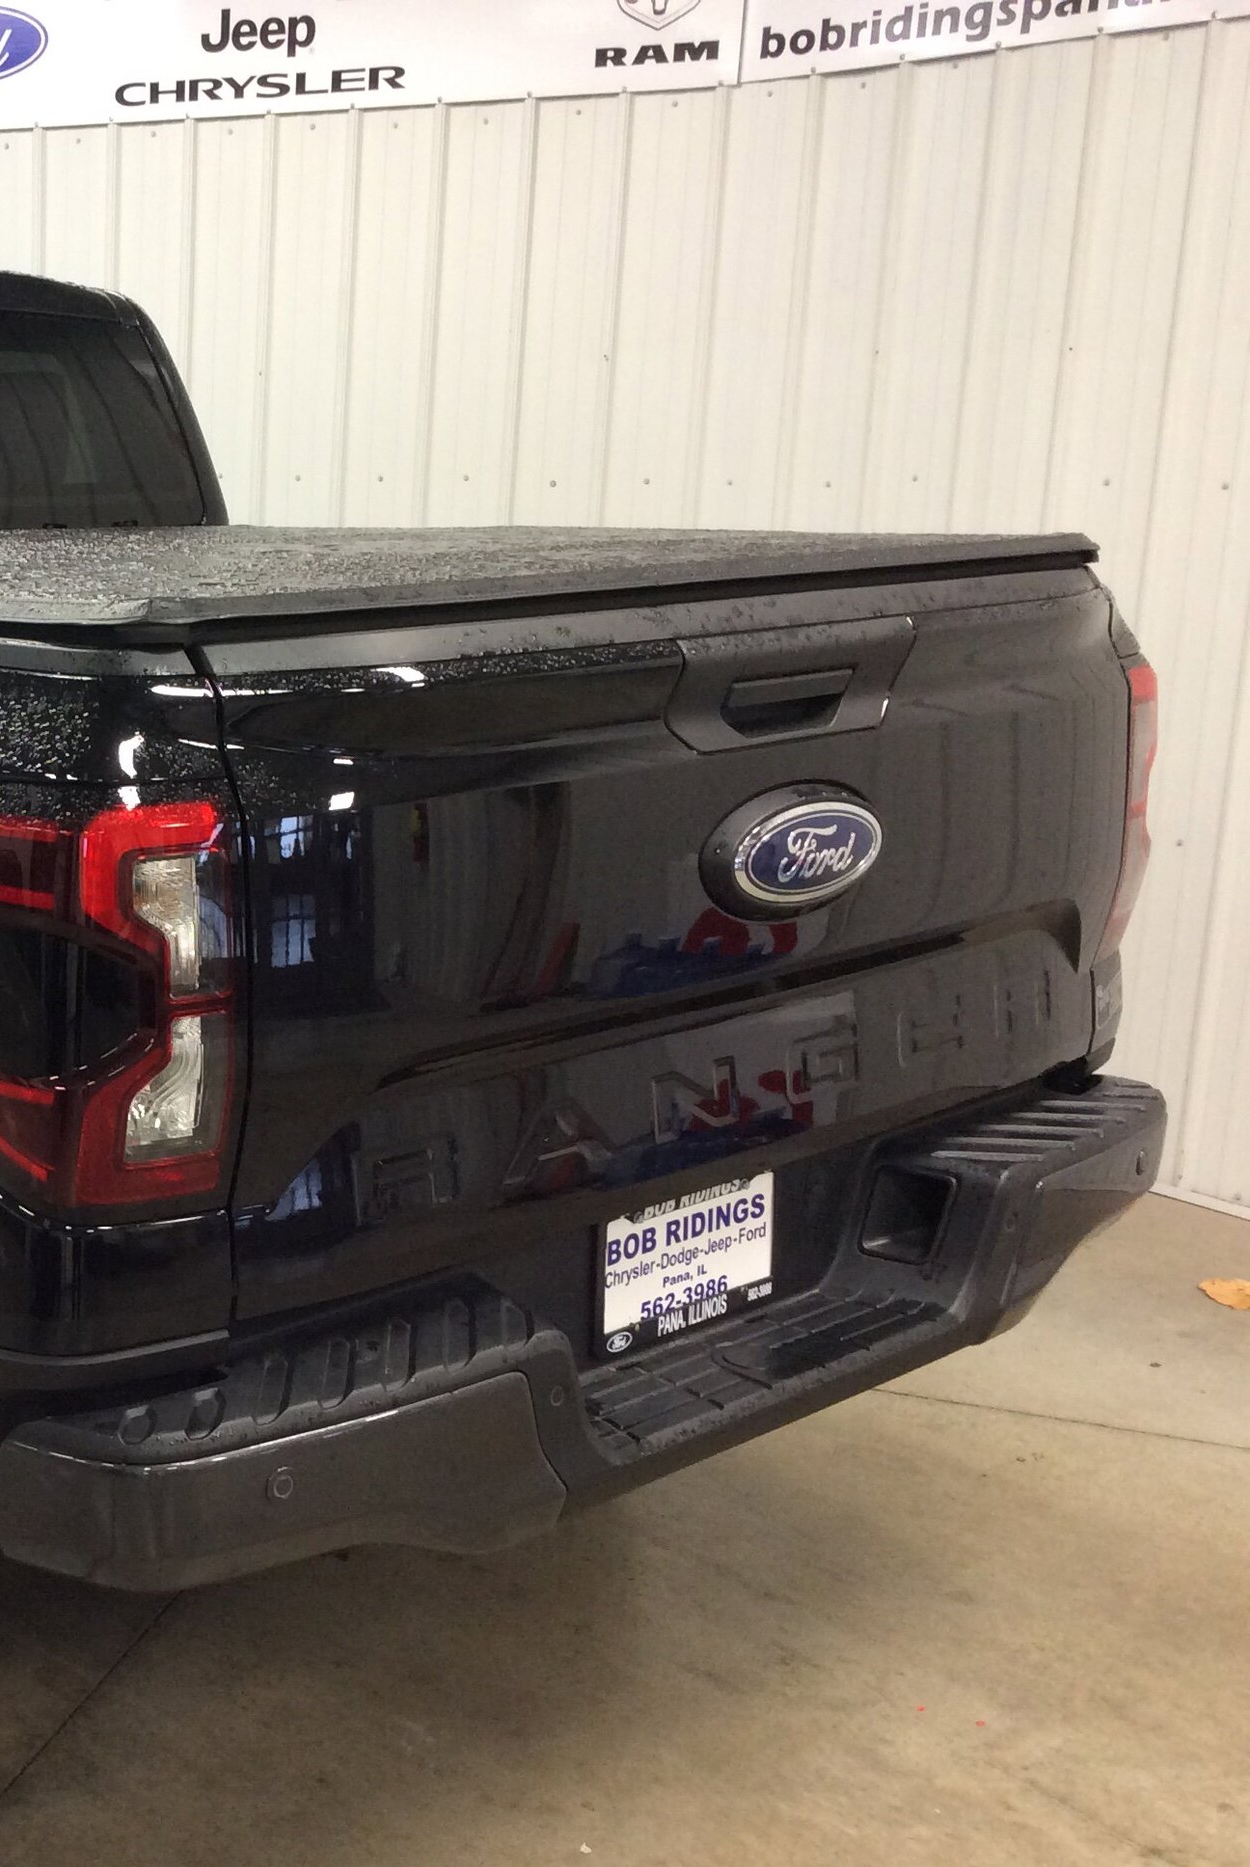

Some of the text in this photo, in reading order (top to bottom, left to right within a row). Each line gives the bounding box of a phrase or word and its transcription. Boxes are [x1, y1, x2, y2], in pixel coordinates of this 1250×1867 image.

[200, 8, 316, 58] Jeep
[594, 39, 720, 68] RAM
[759, 0, 1170, 60] bobridingspa
[114, 65, 407, 107] CHRYSLER
[777, 823, 856, 884] Ford
[606, 1193, 766, 1267] BOB RIDINGS
[604, 1221, 767, 1290] Chrysler-Dodge-Jeep-Ford
[662, 1264, 708, 1289] Pana, IL
[639, 1274, 729, 1321] 562-3986
[688, 1294, 729, 1327] ILLINOIS
